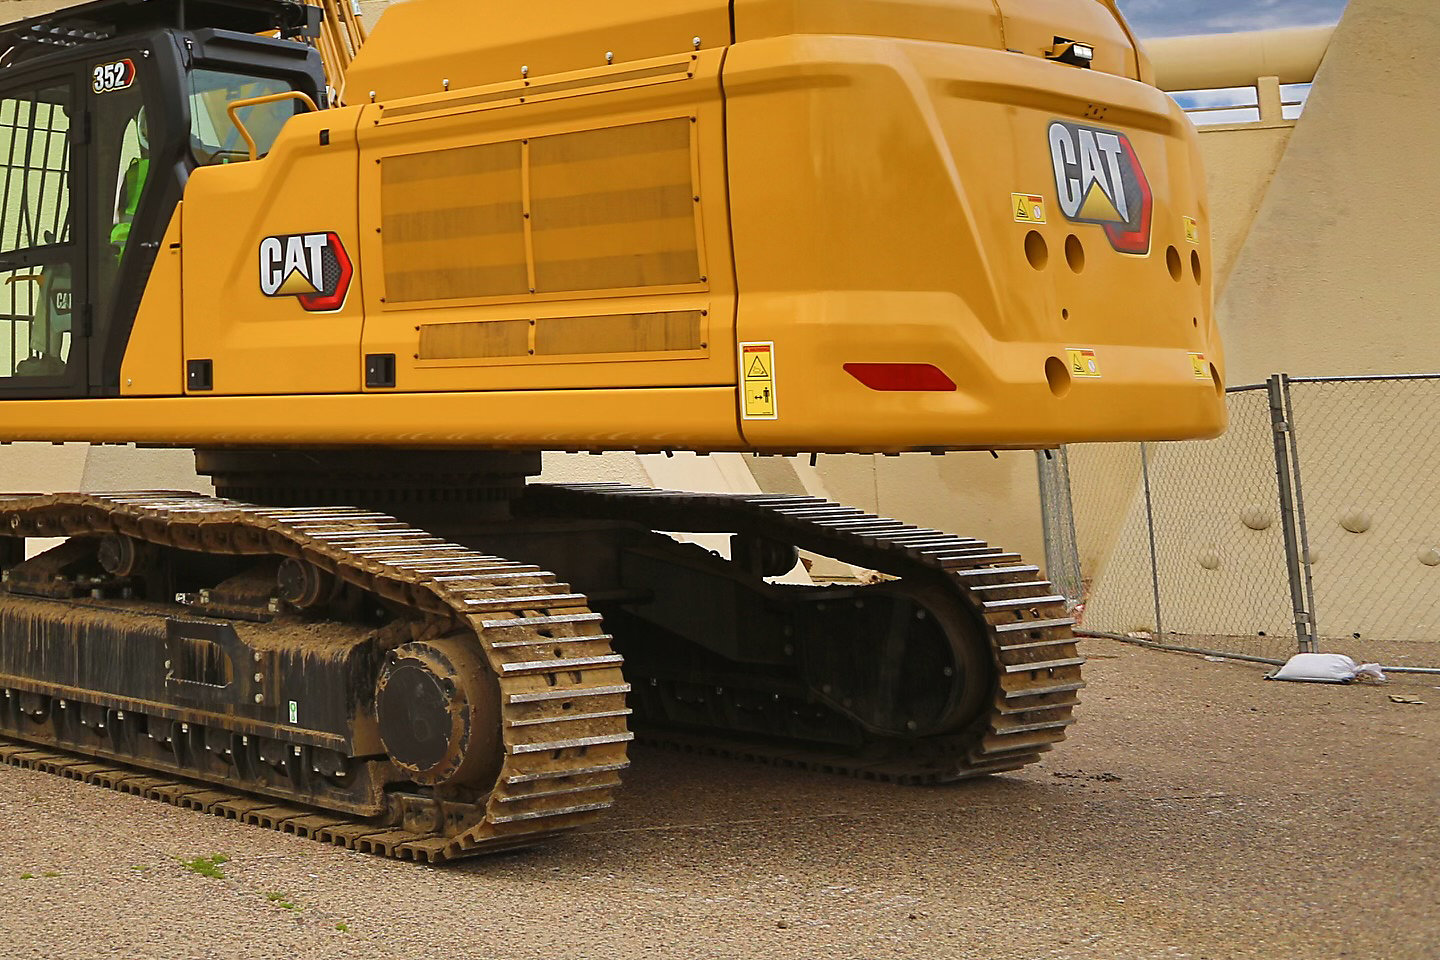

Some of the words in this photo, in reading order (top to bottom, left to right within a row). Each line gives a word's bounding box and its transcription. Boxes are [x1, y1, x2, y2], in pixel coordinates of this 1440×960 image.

[93, 62, 125, 90] 352
[1049, 123, 1129, 223] CAT
[260, 234, 327, 294] CAT
